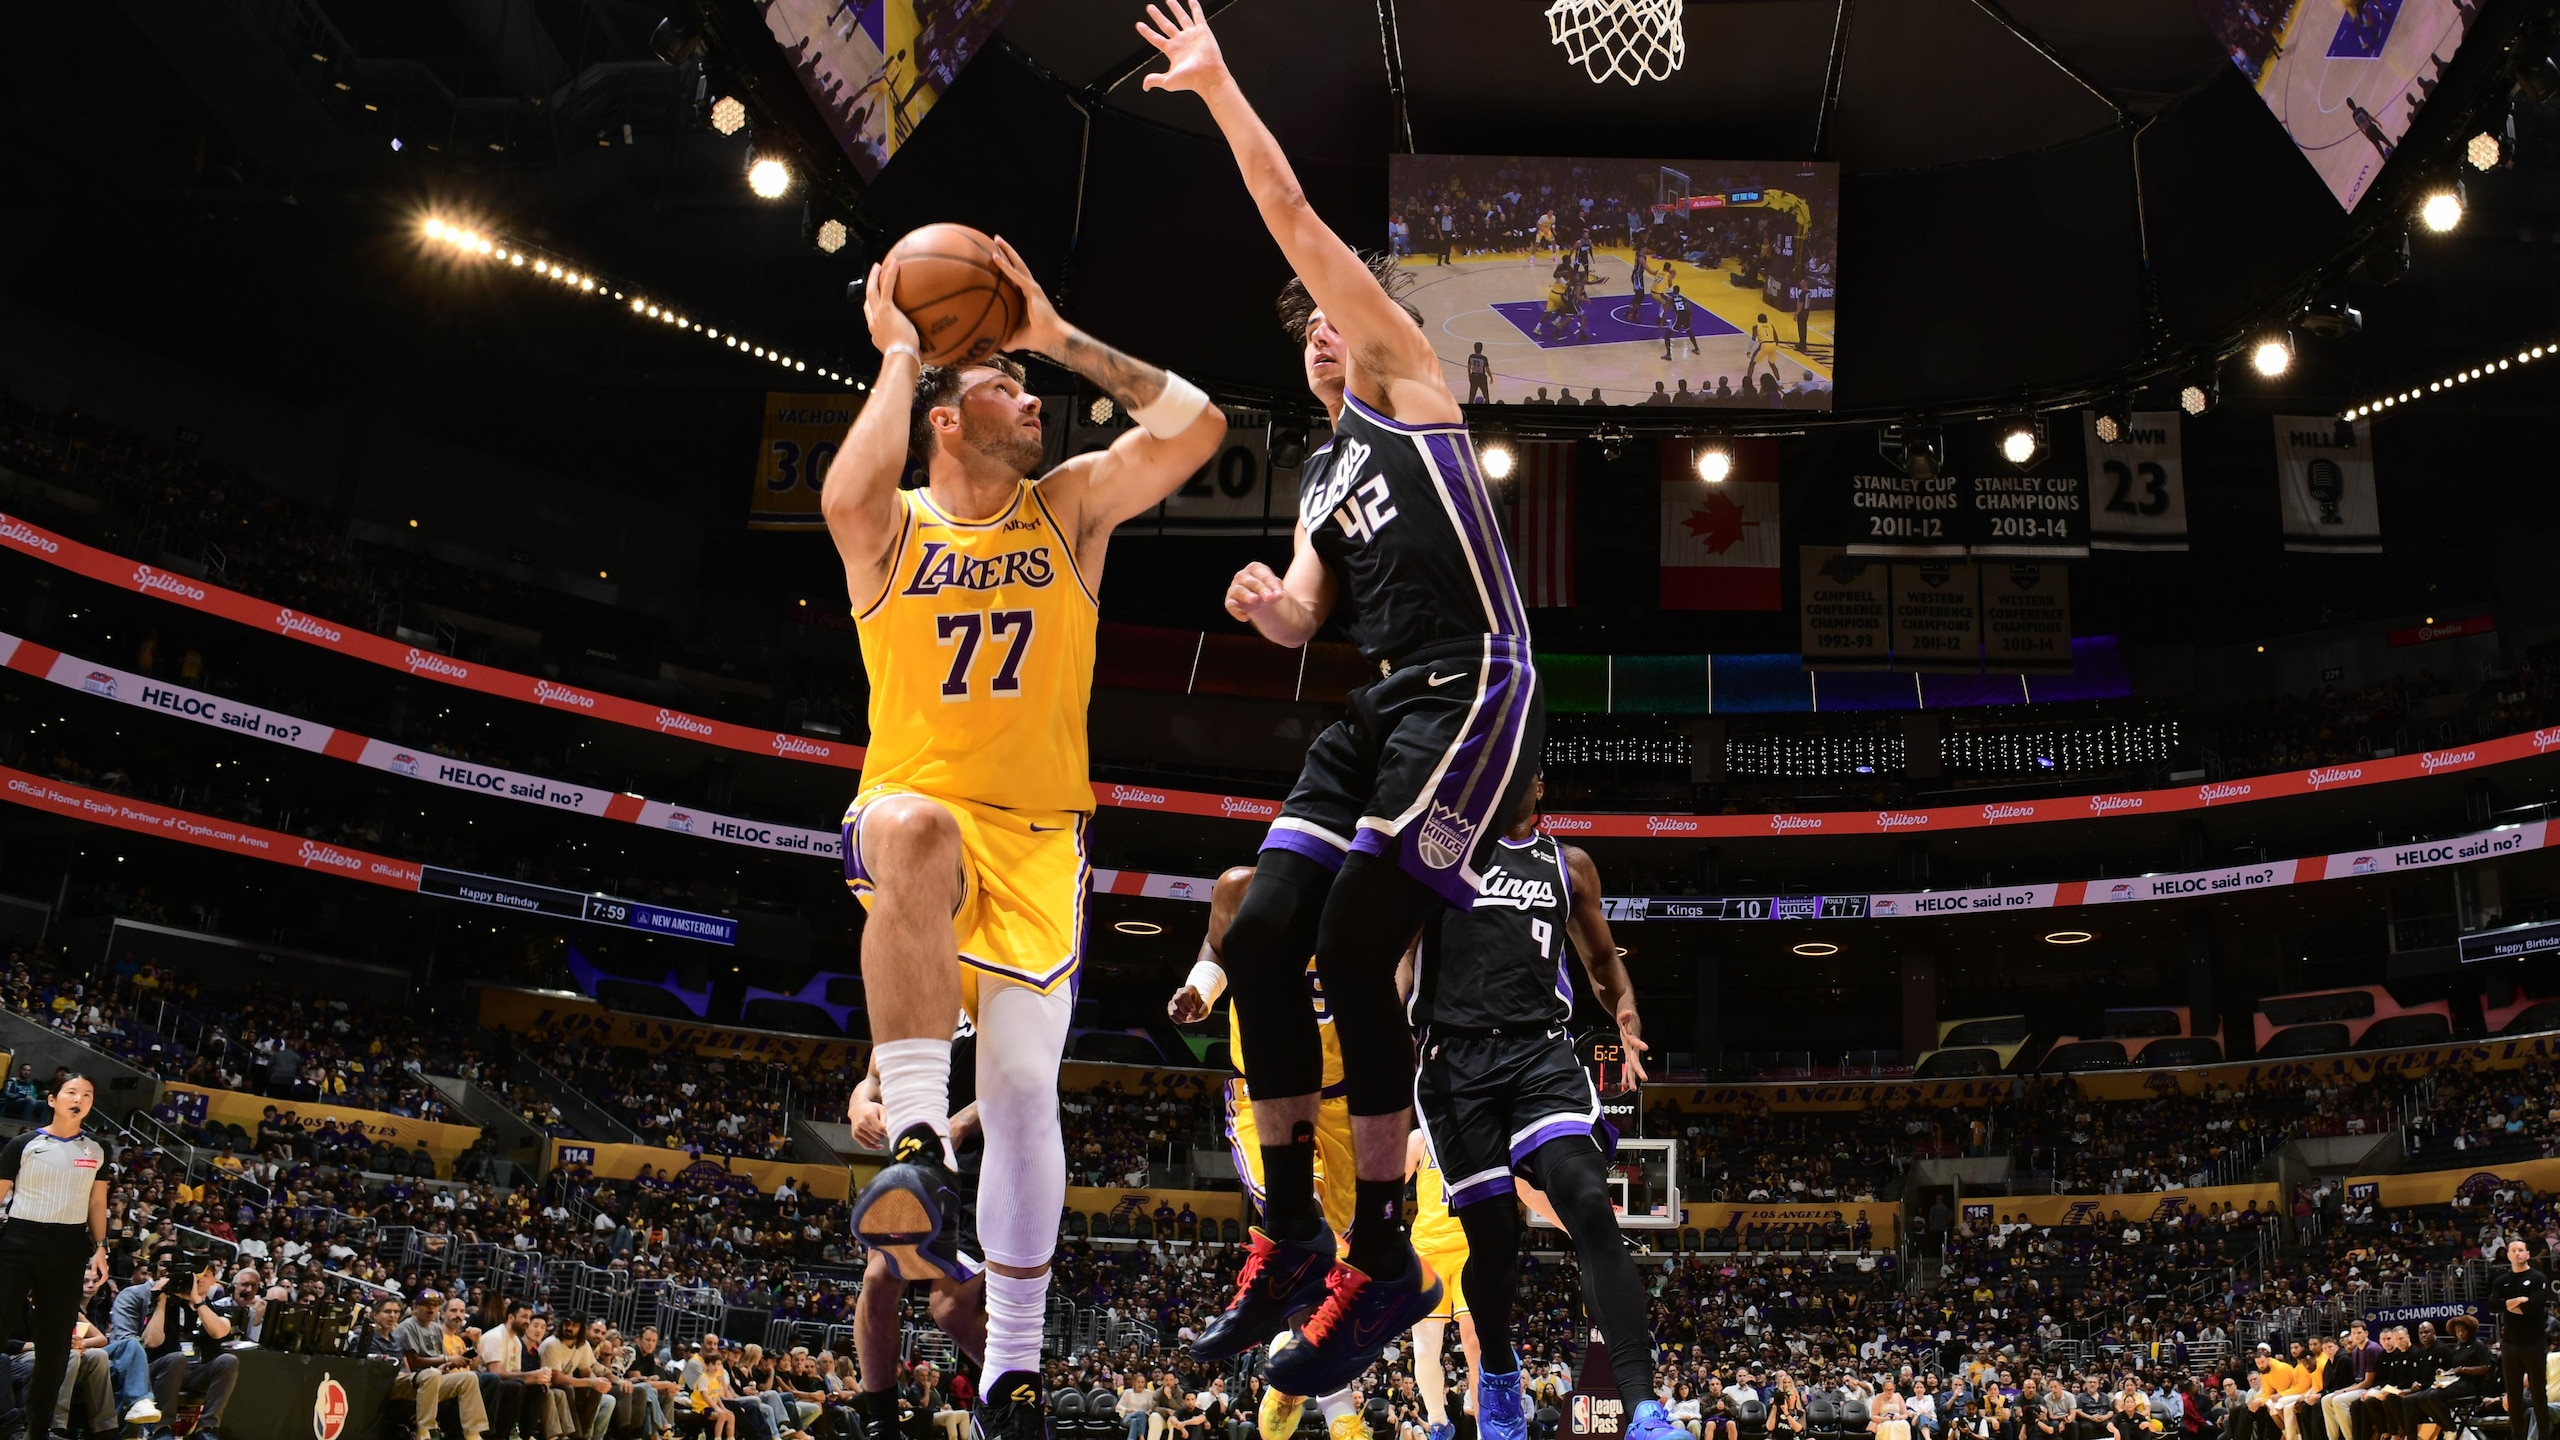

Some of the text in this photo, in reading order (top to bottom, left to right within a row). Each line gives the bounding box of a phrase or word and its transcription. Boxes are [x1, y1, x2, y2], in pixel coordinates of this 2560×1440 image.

[778, 408, 852, 425] VACHON
[2290, 431, 2357, 448] MILL
[1853, 475, 1958, 492] STANLEY CUP
[1974, 476, 2079, 492] STANLEY CUP
[2103, 460, 2170, 516] 23
[1333, 471, 1399, 543] 42
[1852, 491, 1958, 511] CHAMPIONS
[1974, 494, 2081, 511] CHAMPIONS
[1002, 517, 1042, 535] Albert
[1869, 516, 1944, 538] 2011-12
[1990, 517, 2069, 538] 2013-14
[900, 540, 1056, 598] LAKERS
[132, 564, 205, 601] Splitero
[1814, 590, 1874, 602] CAMPBELL
[1906, 591, 1964, 604] WESTERN
[1997, 594, 2055, 607] WESTERN
[1806, 604, 1884, 616] CONFERENCE
[1898, 605, 1974, 618] CONFERENCE
[1989, 608, 2065, 620] CONFERENCE
[275, 608, 341, 644] Splitero
[1810, 617, 1880, 629] CHAMPIONS
[1902, 619, 1970, 632] CHAMPIONS
[1993, 621, 2062, 633] CHAMPIONS
[1817, 634, 1873, 649] 1992-93
[1912, 636, 1961, 650] 2011-12
[2002, 637, 2054, 651] 2013-14
[404, 647, 468, 680] Splitero
[935, 608, 1037, 704] 77
[533, 679, 595, 709] Splitero
[141, 686, 302, 745] HELOC said no?
[655, 708, 713, 736] Splitero
[771, 733, 831, 758] Splitero
[2420, 747, 2476, 774] Splitero
[438, 764, 584, 809] HELOC said no?
[2307, 765, 2363, 791] Splitero
[1111, 784, 1166, 806] Splitero
[2198, 782, 2252, 806] Splitero
[7, 779, 269, 850] Official Home Equity Partner of Crypto.com Arena
[1220, 795, 1274, 817] Splitero
[1981, 803, 2036, 826] Splitero
[2089, 795, 2144, 817] Splitero
[1540, 814, 1593, 836] Splitero
[1646, 815, 1698, 837] Splitero
[1769, 813, 1823, 835] Splitero
[1876, 811, 1929, 833] Splitero
[711, 820, 844, 855] HELOC said no?
[1423, 823, 1464, 856] KINGS
[298, 840, 362, 871] Splitero
[2395, 833, 2523, 866] HELOC said no?
[370, 862, 404, 881] Official
[2152, 868, 2274, 896] HELOC said no?
[458, 886, 540, 911] Happy Birthday
[1914, 890, 2034, 914] HELOC said no?
[592, 902, 626, 921] 7:59
[1629, 904, 1647, 920] 1st
[1666, 903, 1704, 918] Kings
[1736, 901, 1761, 919] 10
[1778, 904, 1815, 914] KINGS
[1830, 905, 1837, 917] 1
[1851, 905, 1859, 917] 7
[651, 913, 671, 928] NEW
[671, 916, 724, 938] AMSTERDAM
[1532, 917, 1552, 959] 9
[2495, 937, 2560, 954] Happy Birthda
[811, 1043, 871, 1062] LA
[1594, 1044, 1625, 1062] 6:2
[2323, 1047, 2491, 1080] ANGELES
[1137, 1071, 1208, 1090] LOS
[1691, 1088, 1758, 1105] LOS
[1766, 1084, 1924, 1104] ANGELES
[1602, 1105, 1635, 1115] SSOT
[564, 1148, 589, 1163] 114
[2352, 1183, 2375, 1199] 117
[1751, 1210, 1838, 1219] LOS ANGELES
[1967, 1205, 1990, 1220] 116
[2378, 1304, 2465, 1322] 17x CHAMPIONS
[1591, 1395, 1624, 1418] Leagu
[1591, 1416, 1619, 1435] Pass
